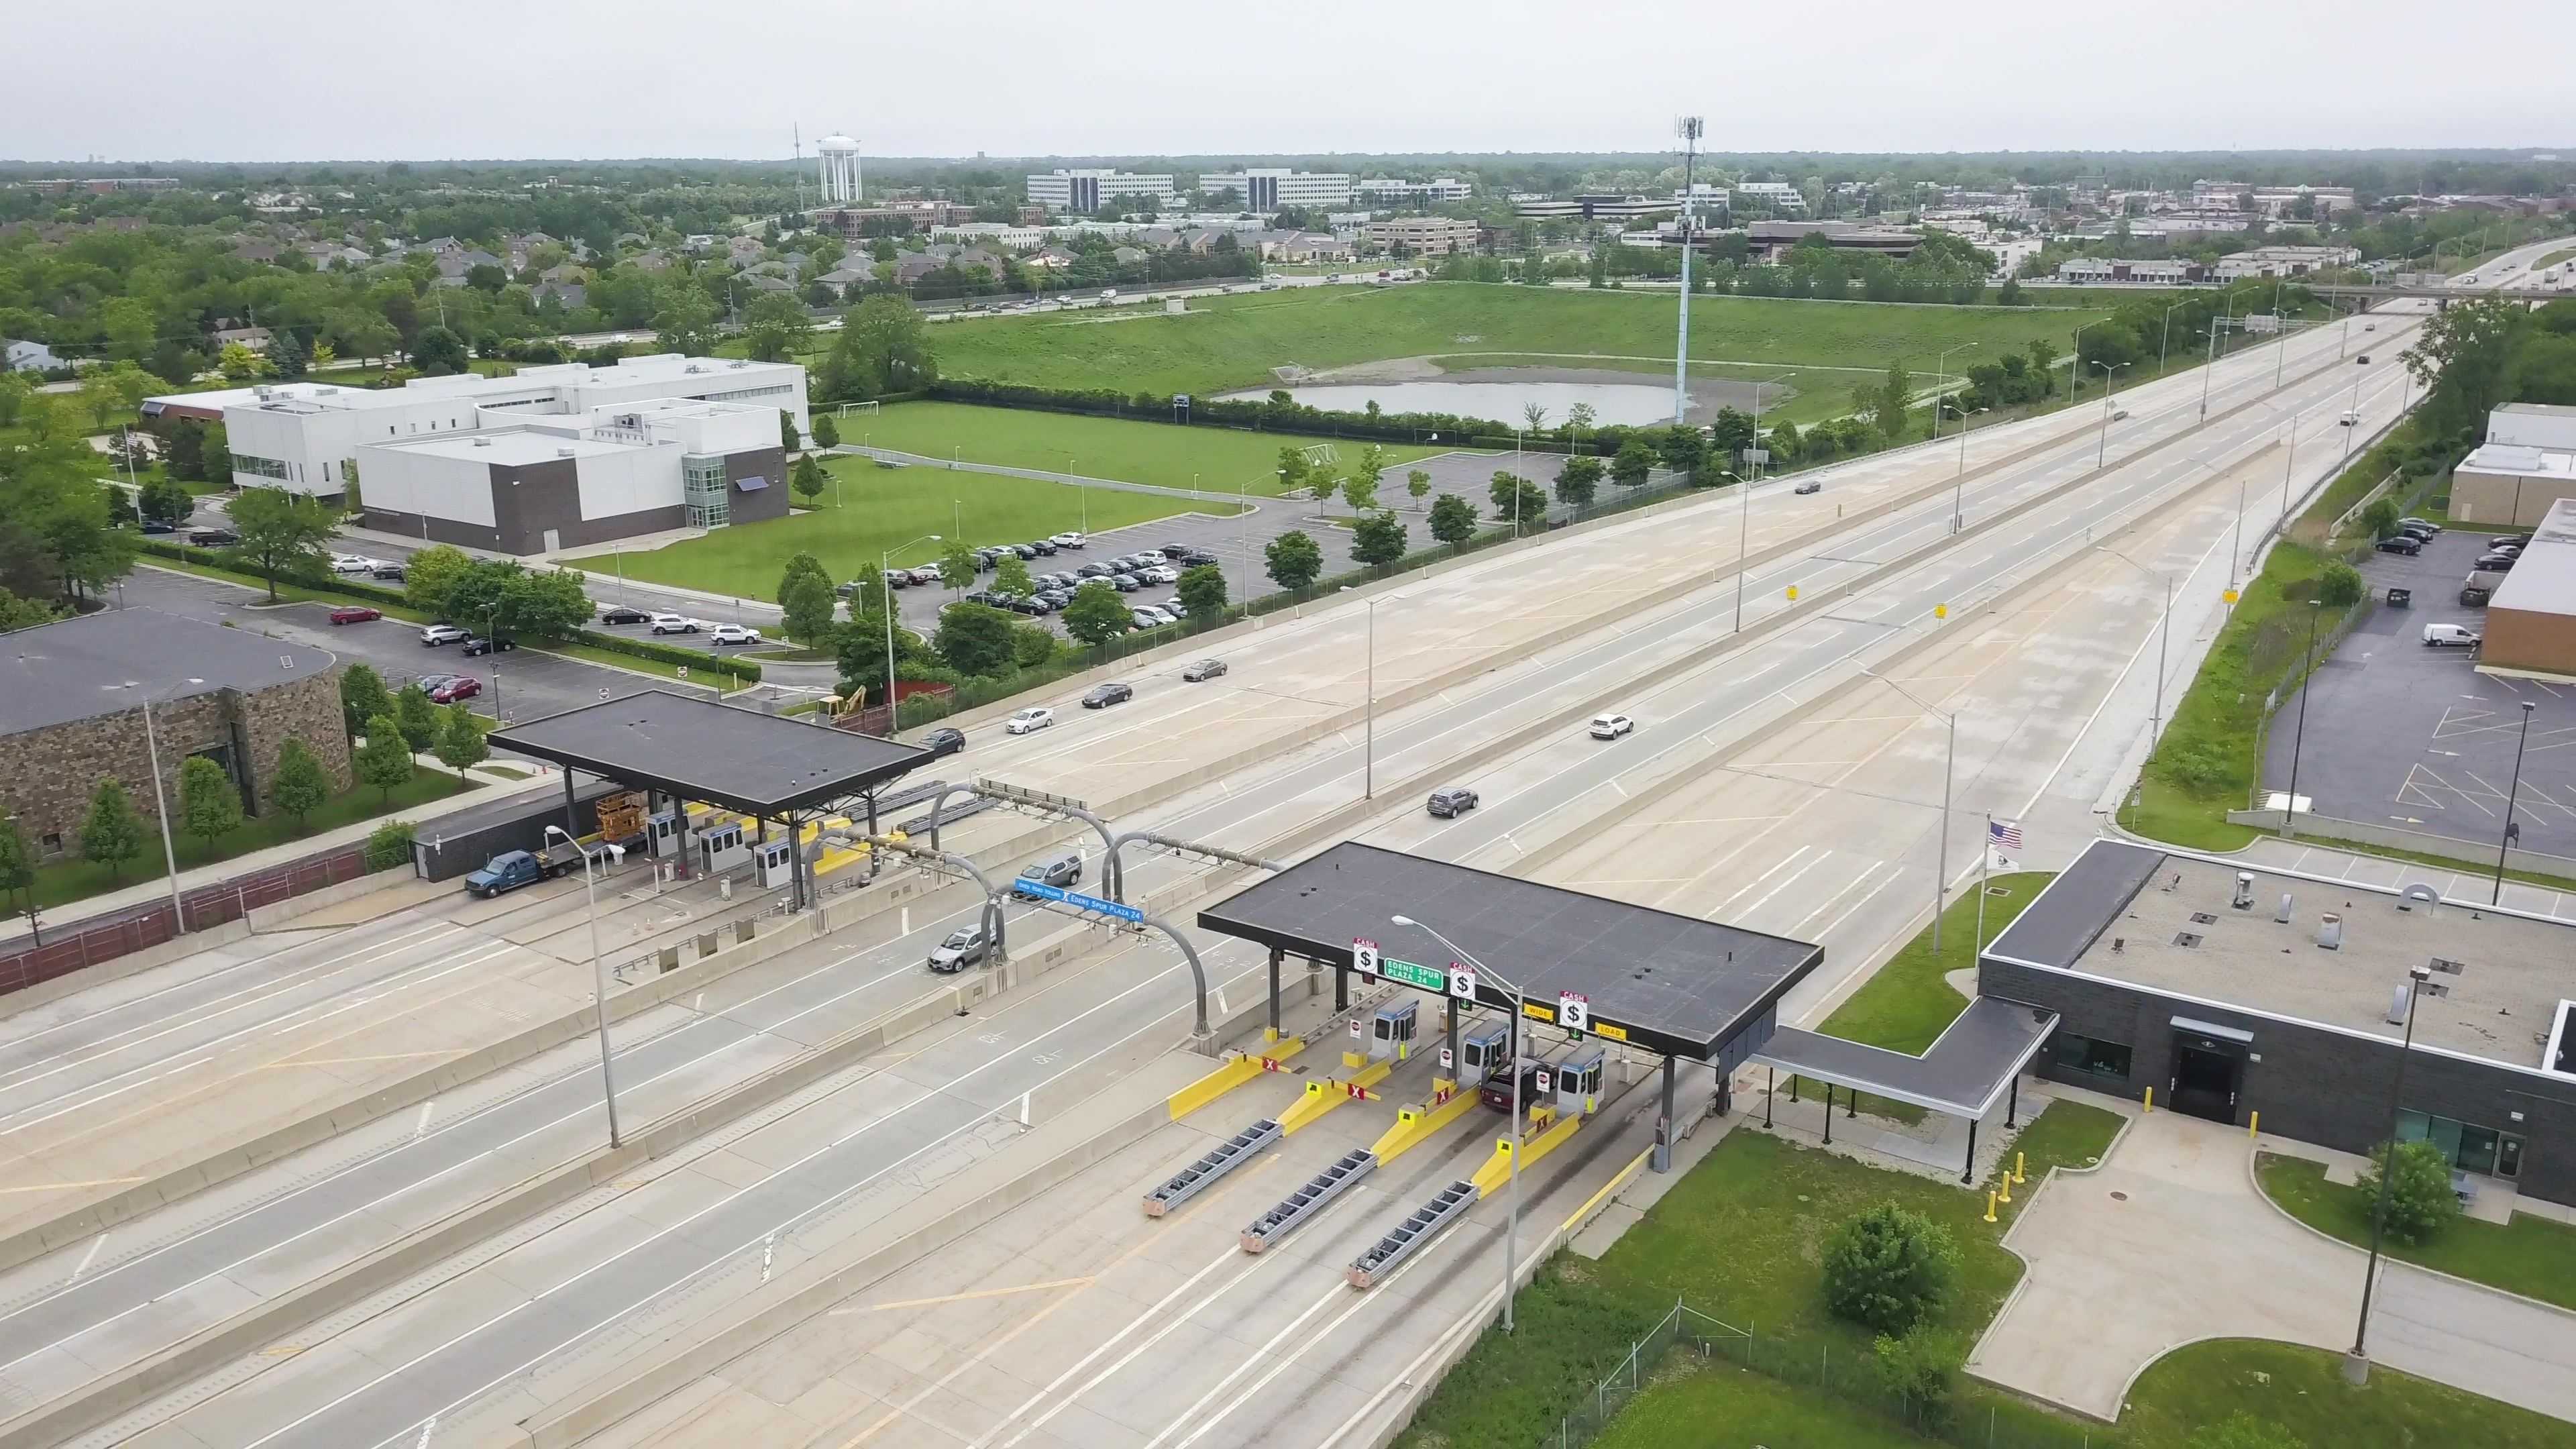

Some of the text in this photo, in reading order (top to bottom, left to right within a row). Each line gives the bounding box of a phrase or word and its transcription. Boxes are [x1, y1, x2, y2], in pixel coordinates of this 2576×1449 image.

[1071, 895, 1089, 906] EDENS
[1091, 901, 1108, 910] SPUR
[1110, 906, 1129, 916] PLAZA
[1356, 938, 1375, 948] CASH
[1388, 961, 1440, 979] EDENS SPUR
[1453, 963, 1472, 973] CASH
[1388, 969, 1428, 984] PLAZA 24
[1564, 991, 1585, 1002] CASH
[1529, 1008, 1548, 1017] WIDE
[1601, 1027, 1621, 1036] LOAD
